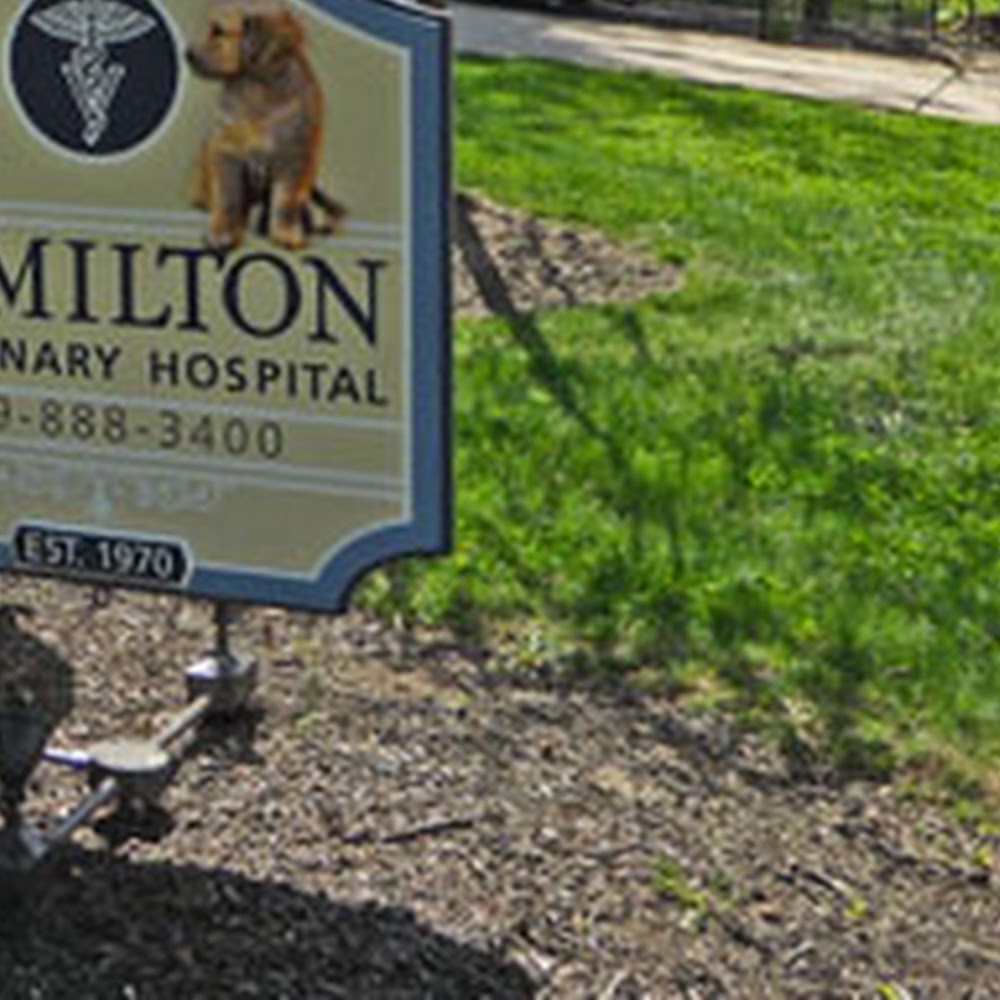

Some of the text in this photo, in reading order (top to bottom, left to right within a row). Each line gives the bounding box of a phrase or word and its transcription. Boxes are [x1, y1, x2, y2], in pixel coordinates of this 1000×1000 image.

[150, 352, 389, 407] HOSPITAL
[22, 532, 175, 580] EST. 1970
